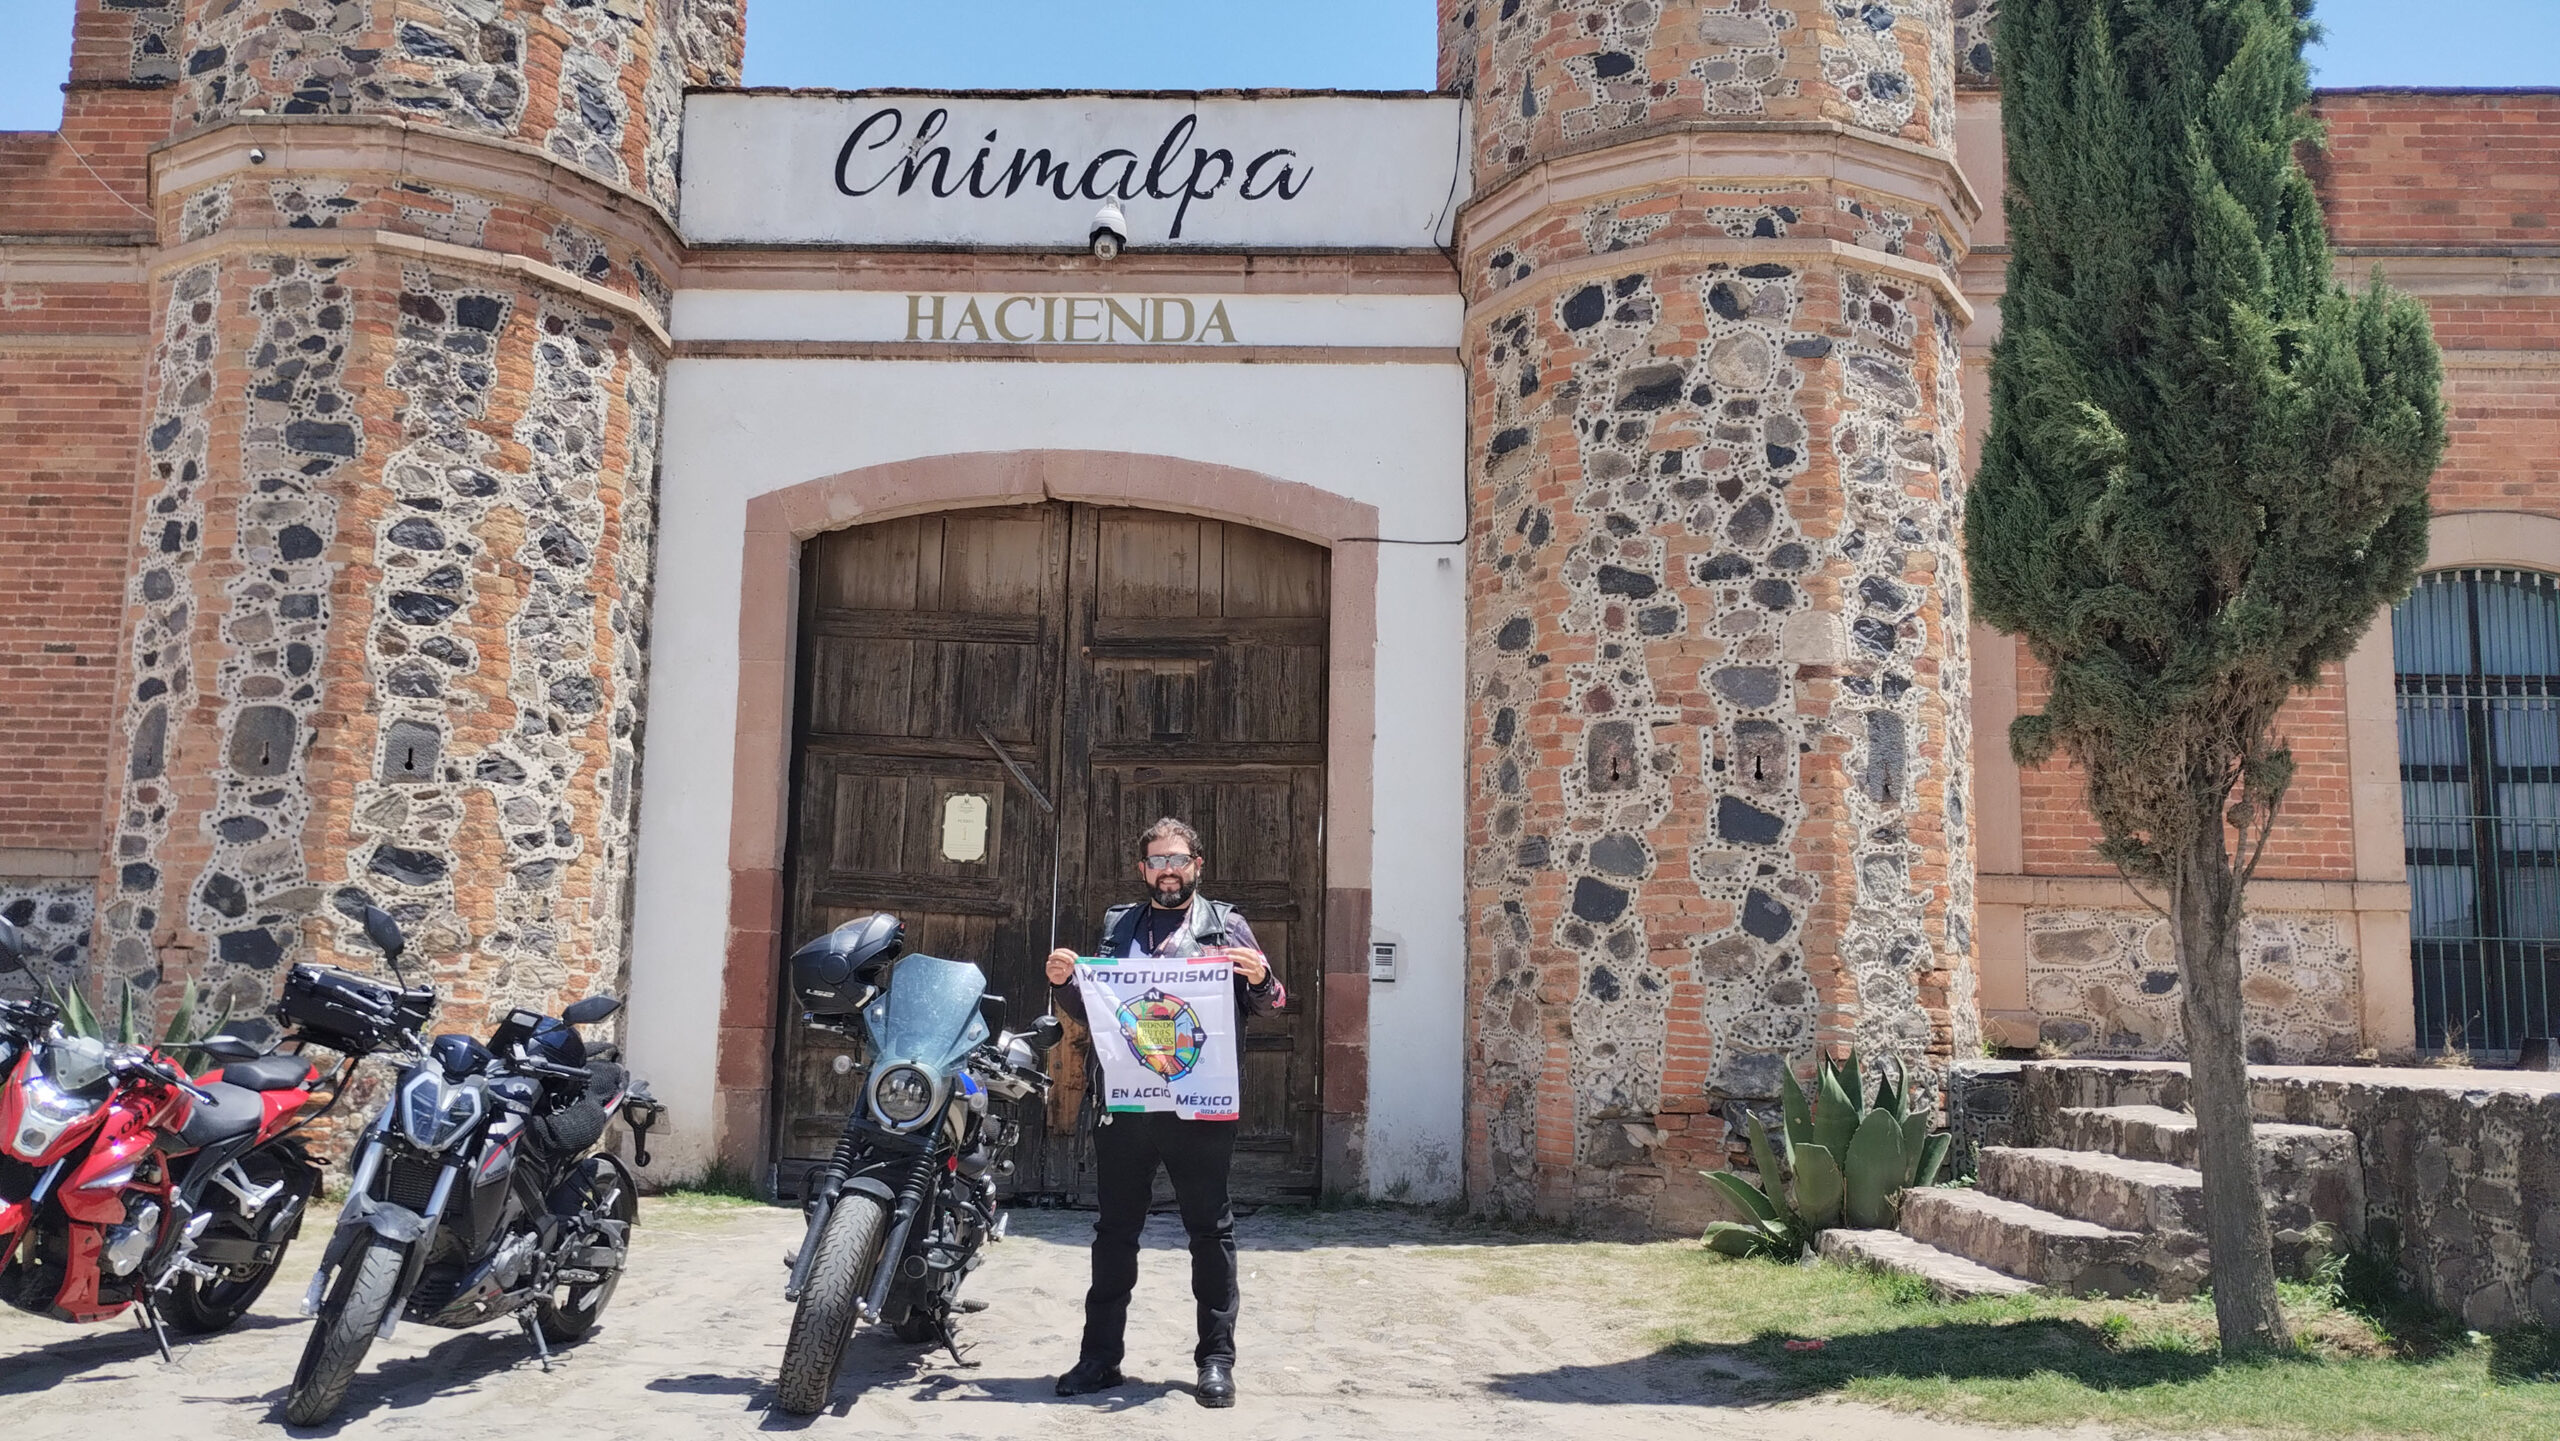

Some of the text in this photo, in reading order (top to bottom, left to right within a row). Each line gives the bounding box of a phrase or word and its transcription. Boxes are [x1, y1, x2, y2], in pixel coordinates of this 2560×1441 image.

[835, 108, 1314, 239] Chimalpa
[904, 295, 1239, 343] HACIENDA
[1148, 991, 1160, 999] N
[1111, 1088, 1129, 1099] EN
[1175, 1092, 1232, 1106] MÉXICO
